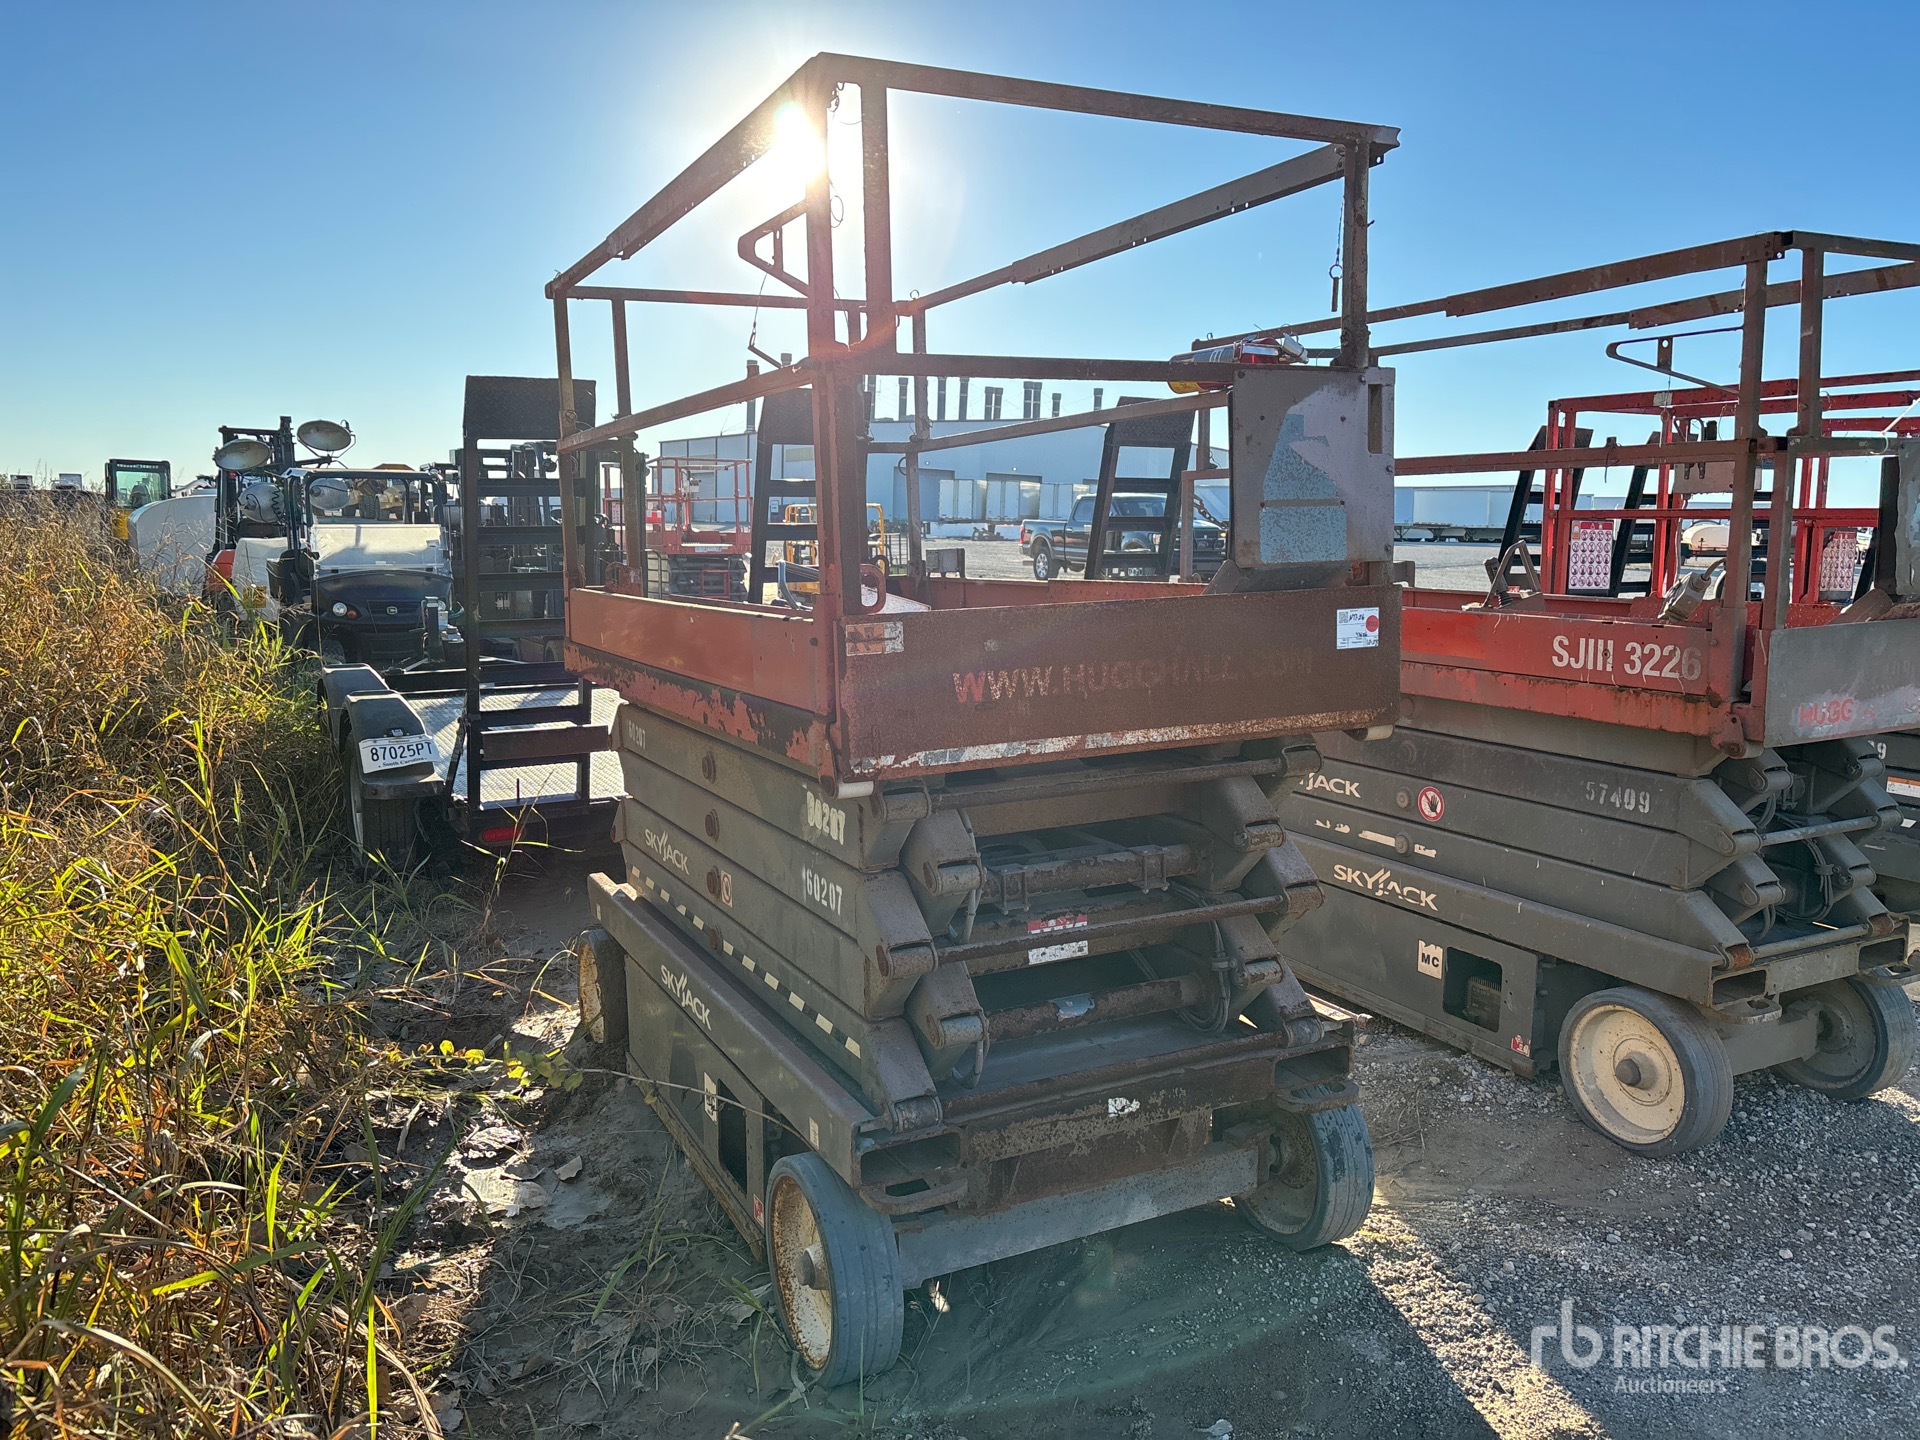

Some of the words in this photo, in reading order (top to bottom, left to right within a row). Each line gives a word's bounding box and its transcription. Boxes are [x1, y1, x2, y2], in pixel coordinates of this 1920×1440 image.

[1623, 641, 1701, 681] 3226
[370, 741, 432, 762] 87025PT
[1585, 781, 1650, 813] 57409
[645, 828, 690, 875] SKYJACK
[806, 868, 843, 916] 60207
[1333, 864, 1438, 912] SKYJACK
[1421, 952, 1440, 968] MC
[660, 964, 712, 1031] SKYJACK
